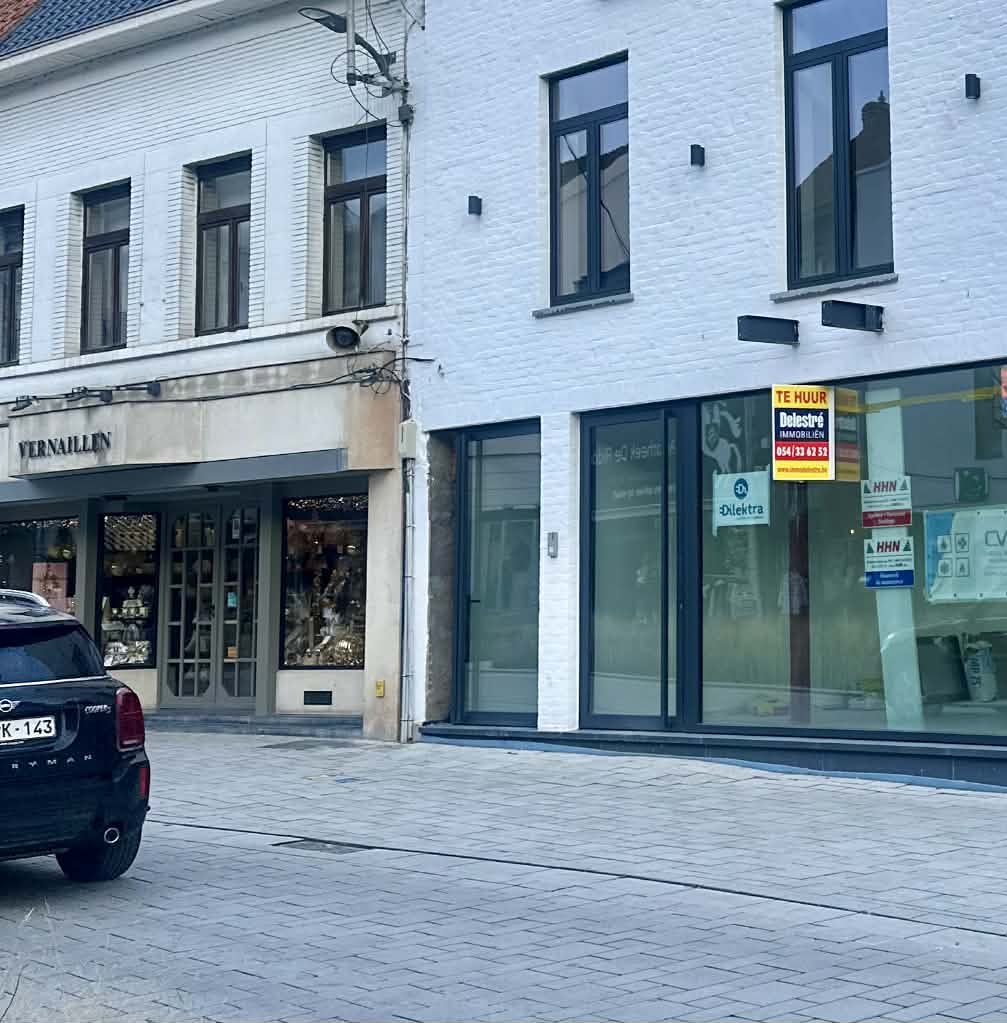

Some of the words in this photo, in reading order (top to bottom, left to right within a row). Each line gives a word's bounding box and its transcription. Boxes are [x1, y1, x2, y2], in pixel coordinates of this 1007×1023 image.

[775, 391, 791, 403] TE
[794, 391, 827, 404] HUUR
[779, 411, 824, 428] Delestré
[779, 429, 825, 439] IMMOBILIËN
[18, 431, 112, 458] VERNAILLEN
[776, 445, 805, 457] 054/33
[807, 446, 817, 457] 62
[818, 446, 828, 457] 52
[873, 479, 897, 492] HHN
[719, 503, 764, 516] Dilektra
[876, 540, 901, 553] HHN
[0, 719, 53, 738] K-143
